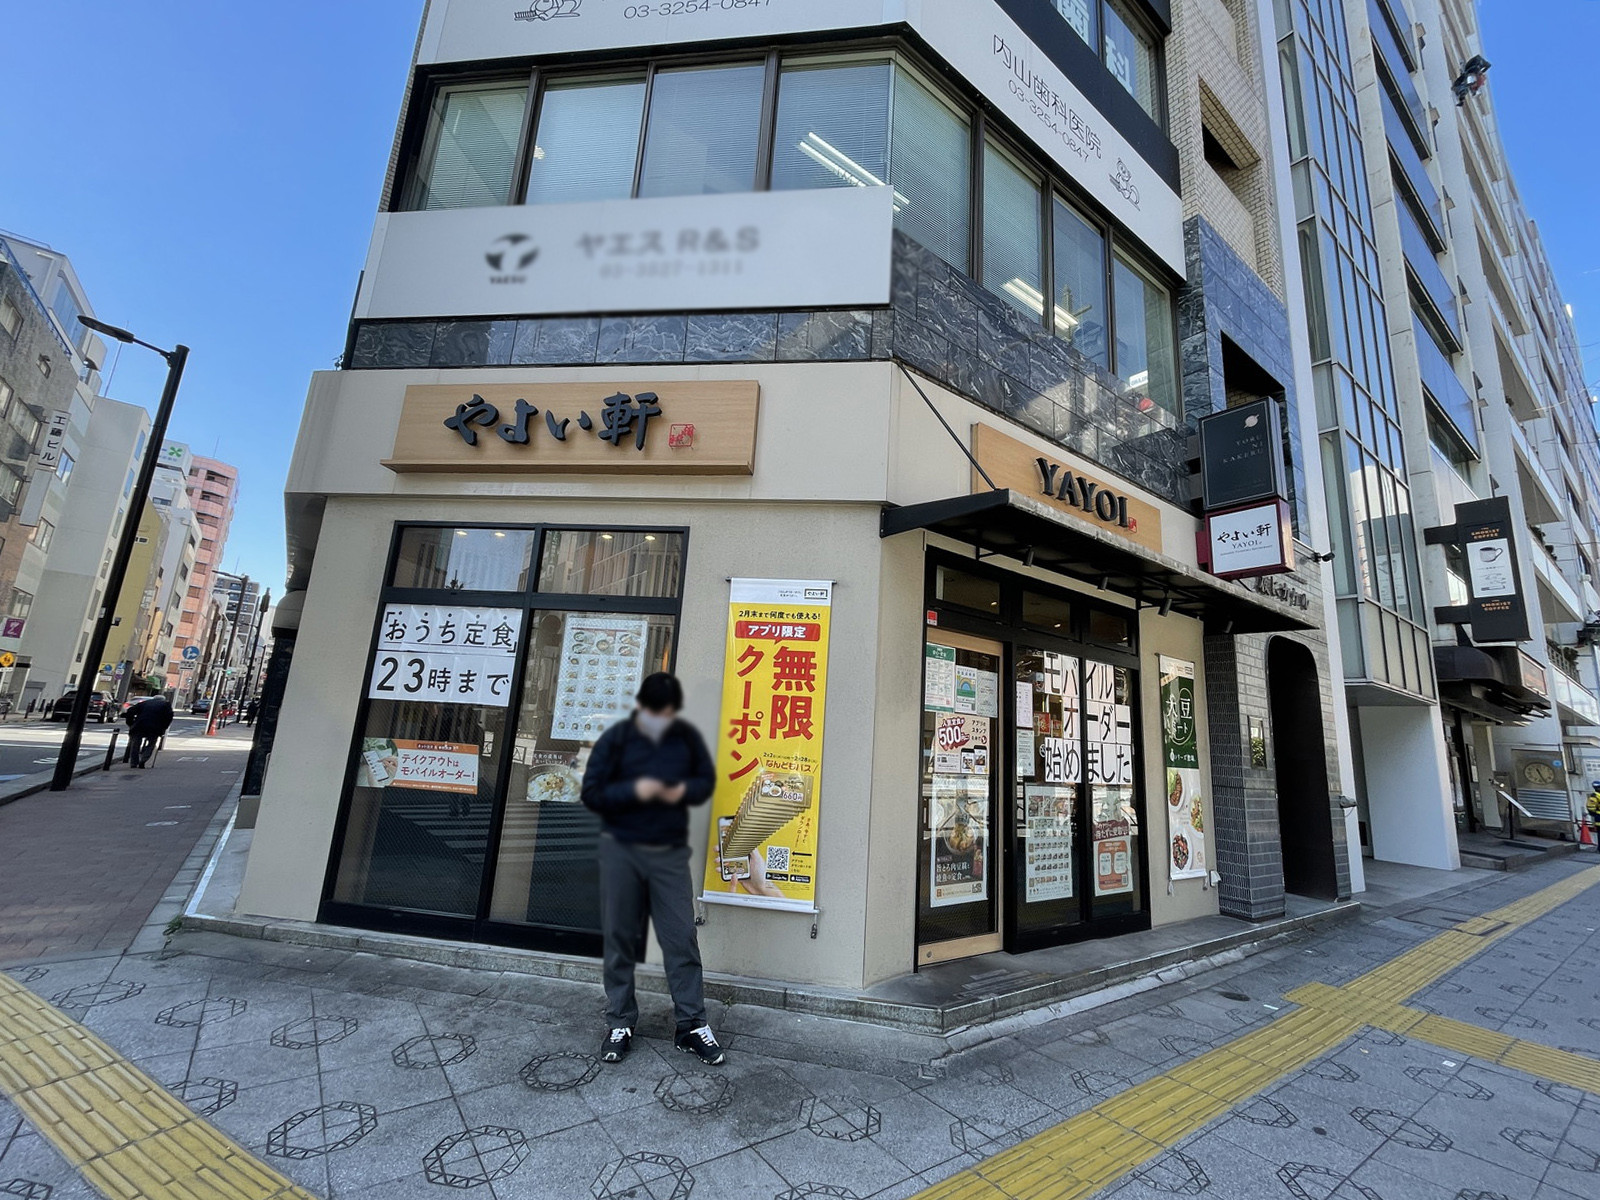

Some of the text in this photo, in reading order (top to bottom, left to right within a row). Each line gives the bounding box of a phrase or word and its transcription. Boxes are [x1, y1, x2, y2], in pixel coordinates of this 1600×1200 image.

[992, 34, 1102, 160] 内山歯科医院
[1008, 79, 1090, 163] 03-3254-0847
[42, 414, 67, 462] 工藤ビル
[443, 391, 662, 451] やよい軒
[1034, 457, 1129, 528] YAYOI
[1217, 523, 1272, 543] やよい軒
[1232, 540, 1258, 550] YAYOI
[739, 610, 821, 620] 2月末まで何度でも使える!
[748, 624, 806, 638] アプリ限定
[376, 657, 509, 696] 23時まで
[770, 645, 817, 741] 無限
[1045, 653, 1113, 699] モバイル
[728, 644, 765, 782] クーポン
[1064, 698, 1131, 741] オーダー
[401, 753, 459, 768] テイクアウトは
[401, 766, 475, 782] モバイルオーダー!
[1046, 738, 1131, 783] 始めました
